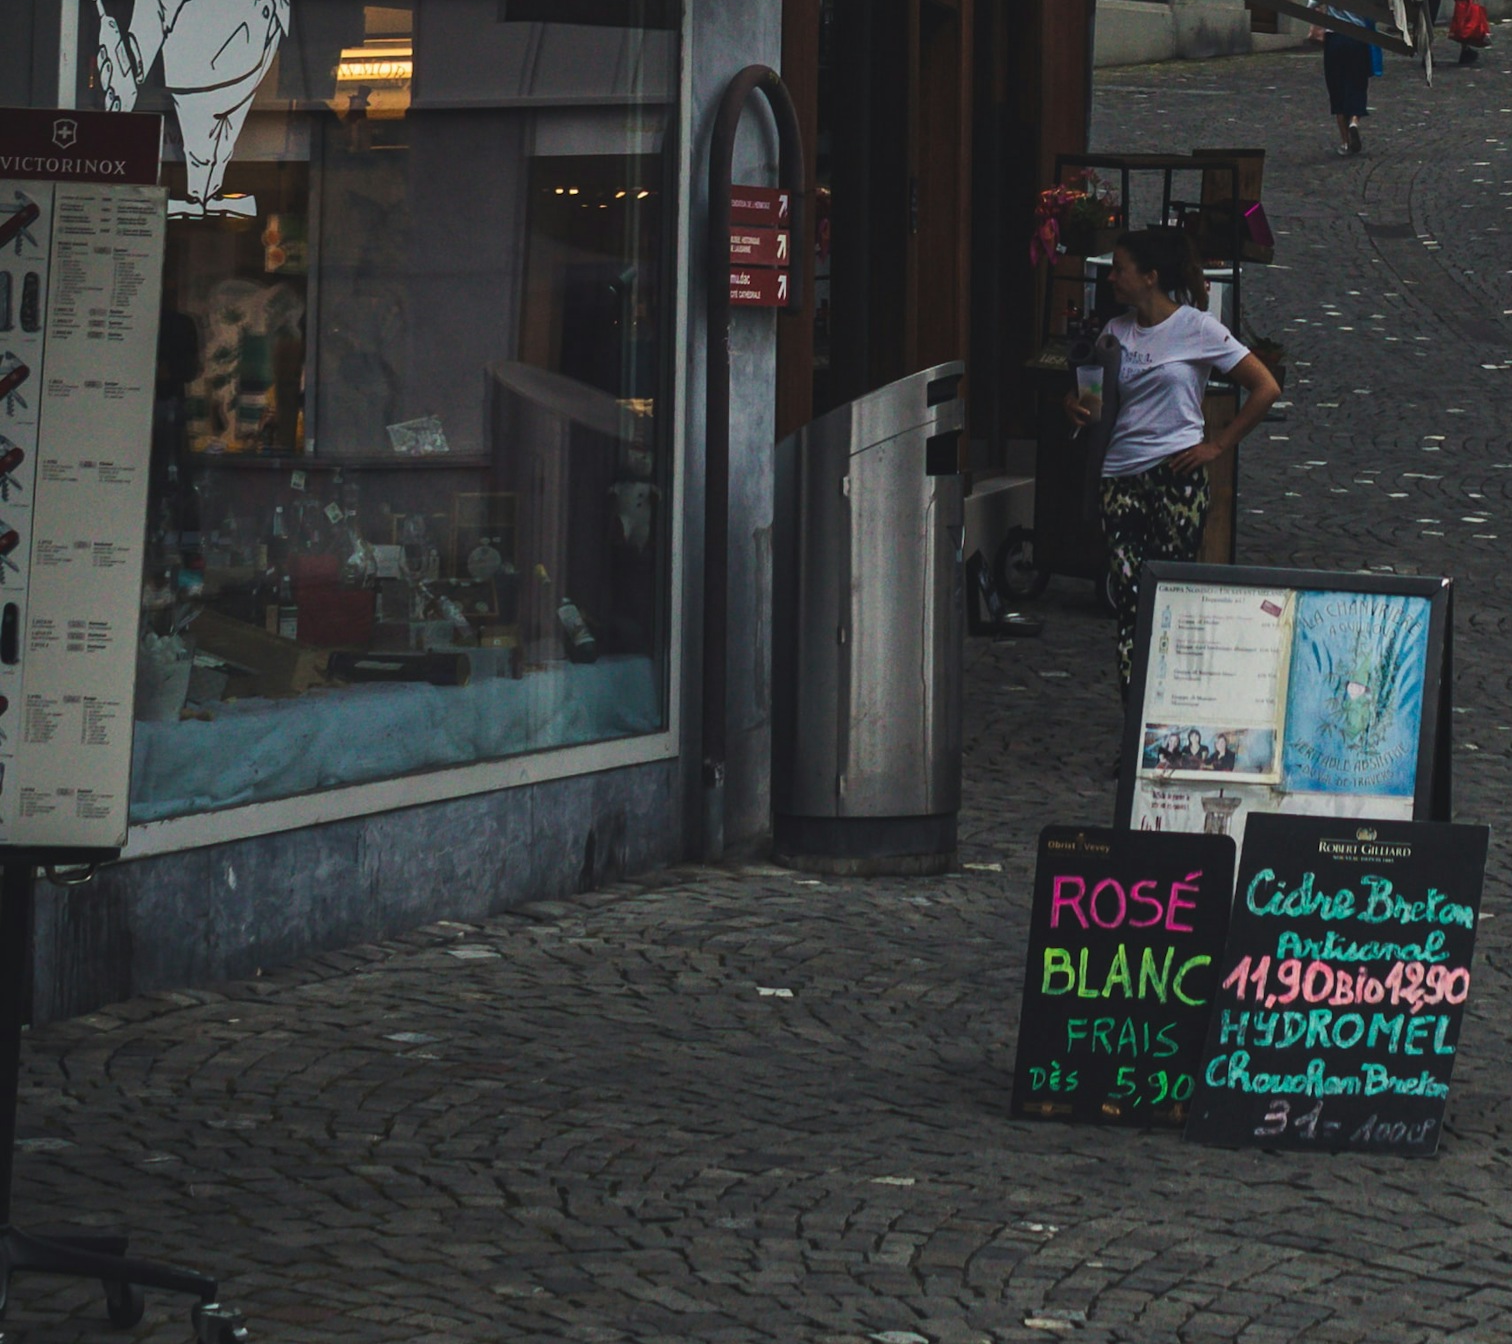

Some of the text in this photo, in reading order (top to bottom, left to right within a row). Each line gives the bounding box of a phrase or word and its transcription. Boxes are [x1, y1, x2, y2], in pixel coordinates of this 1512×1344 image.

[0, 155, 127, 176] VICTORINOX
[1050, 869, 1203, 933] ROSÉ
[1246, 867, 1474, 930] Cidre Breton
[1276, 929, 1451, 963] Artisanal
[1041, 942, 1212, 1007] BLANC
[1221, 954, 1335, 1010] 11,90
[1066, 1016, 1180, 1058] FRAIS
[1218, 1007, 1457, 1055] HYDROMEL
[1028, 1060, 1196, 1108] DÈS 5,90
[1361, 1062, 1450, 1100] Breton
